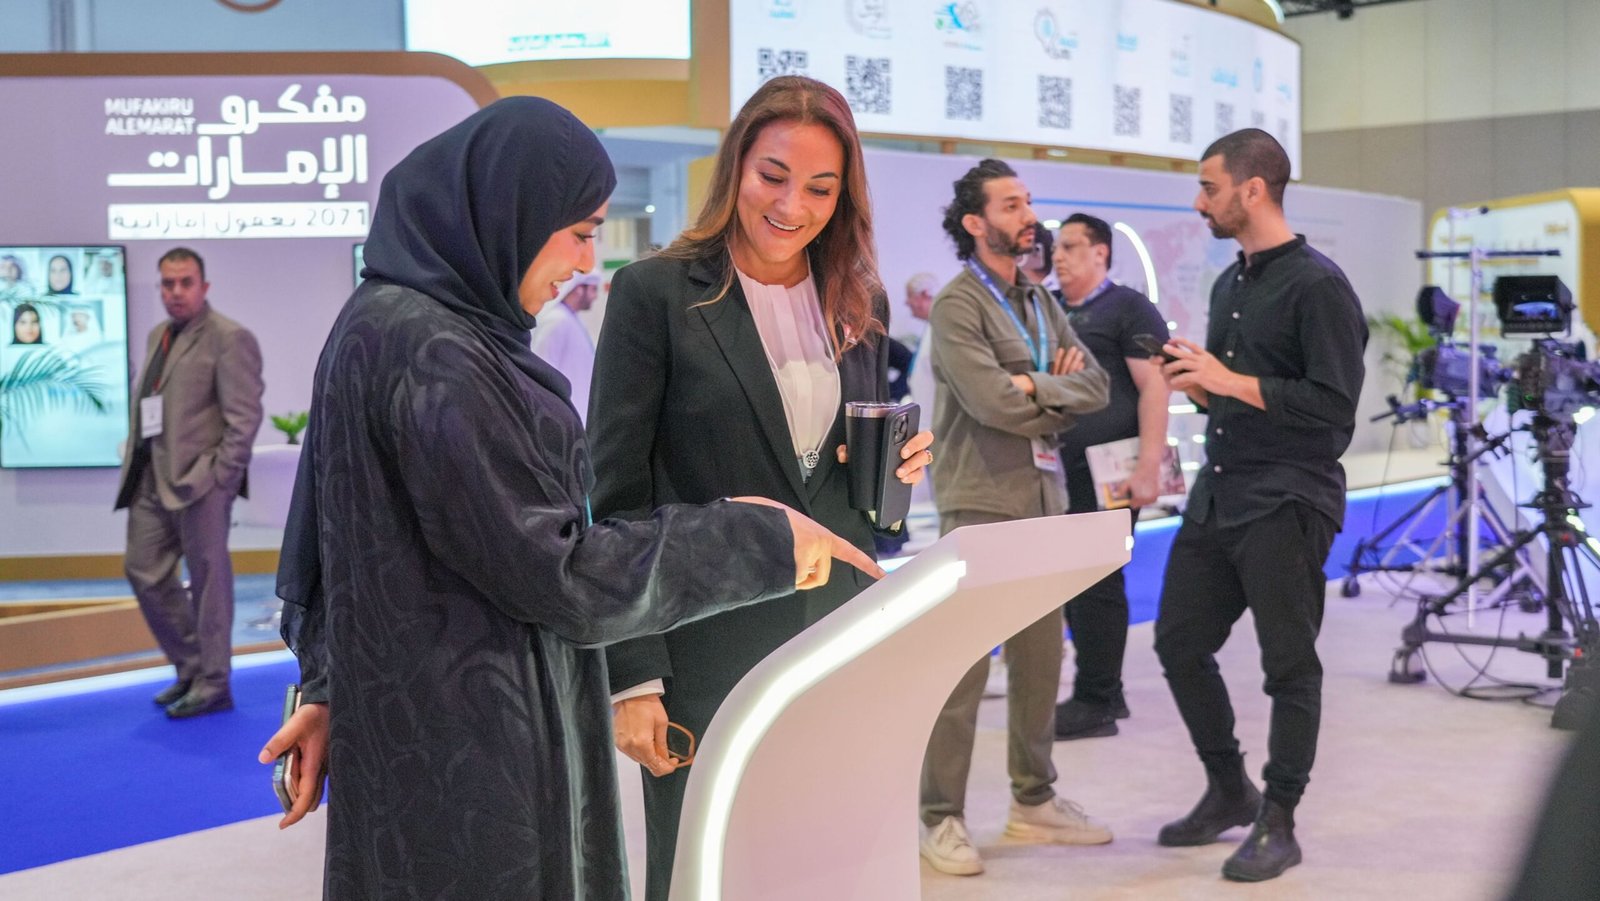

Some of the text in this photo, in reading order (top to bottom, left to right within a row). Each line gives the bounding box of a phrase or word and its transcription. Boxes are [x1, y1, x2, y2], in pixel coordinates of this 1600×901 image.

[104, 98, 194, 116] MUFAKIRU
[197, 84, 367, 135] مفكرو
[104, 118, 196, 136] ALEMARAT
[107, 134, 368, 200] الإمارات
[305, 207, 367, 227] 2071
